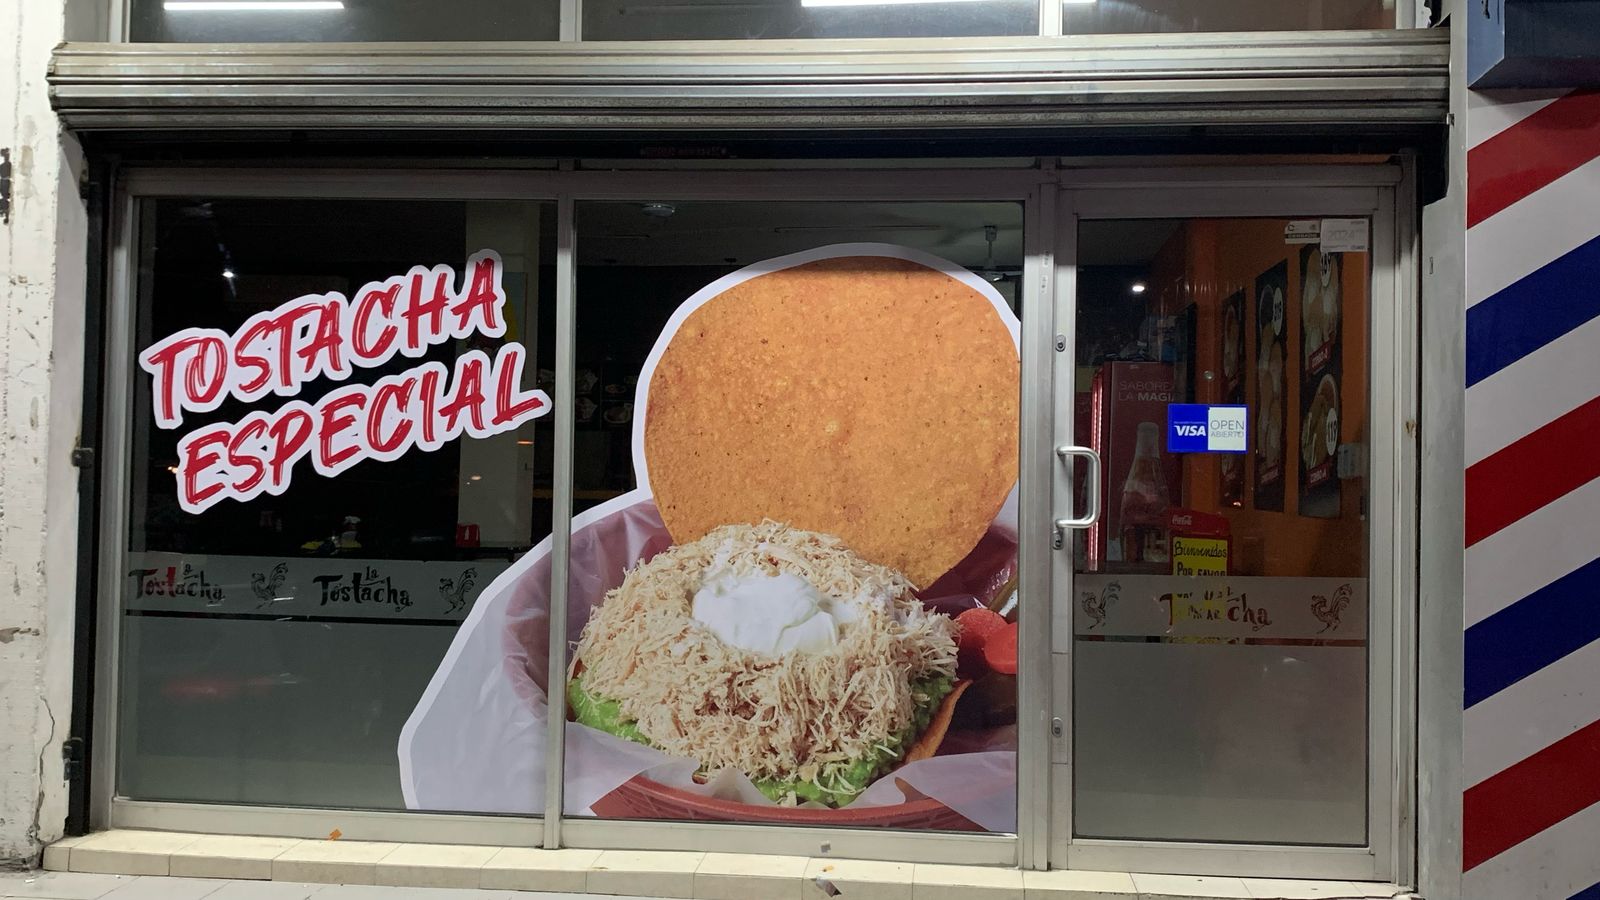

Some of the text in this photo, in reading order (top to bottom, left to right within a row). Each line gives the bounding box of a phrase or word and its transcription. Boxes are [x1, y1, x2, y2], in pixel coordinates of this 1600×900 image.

[148, 258, 498, 420] TOSTACHA
[1118, 392, 1134, 401] LA
[184, 351, 544, 504] ESPECIAL
[1173, 425, 1207, 437] VISA
[1210, 420, 1244, 431] OPEN
[1173, 540, 1227, 558] Bienvenidos
[128, 566, 227, 603] Tostacha
[312, 572, 413, 612] Tostacha
